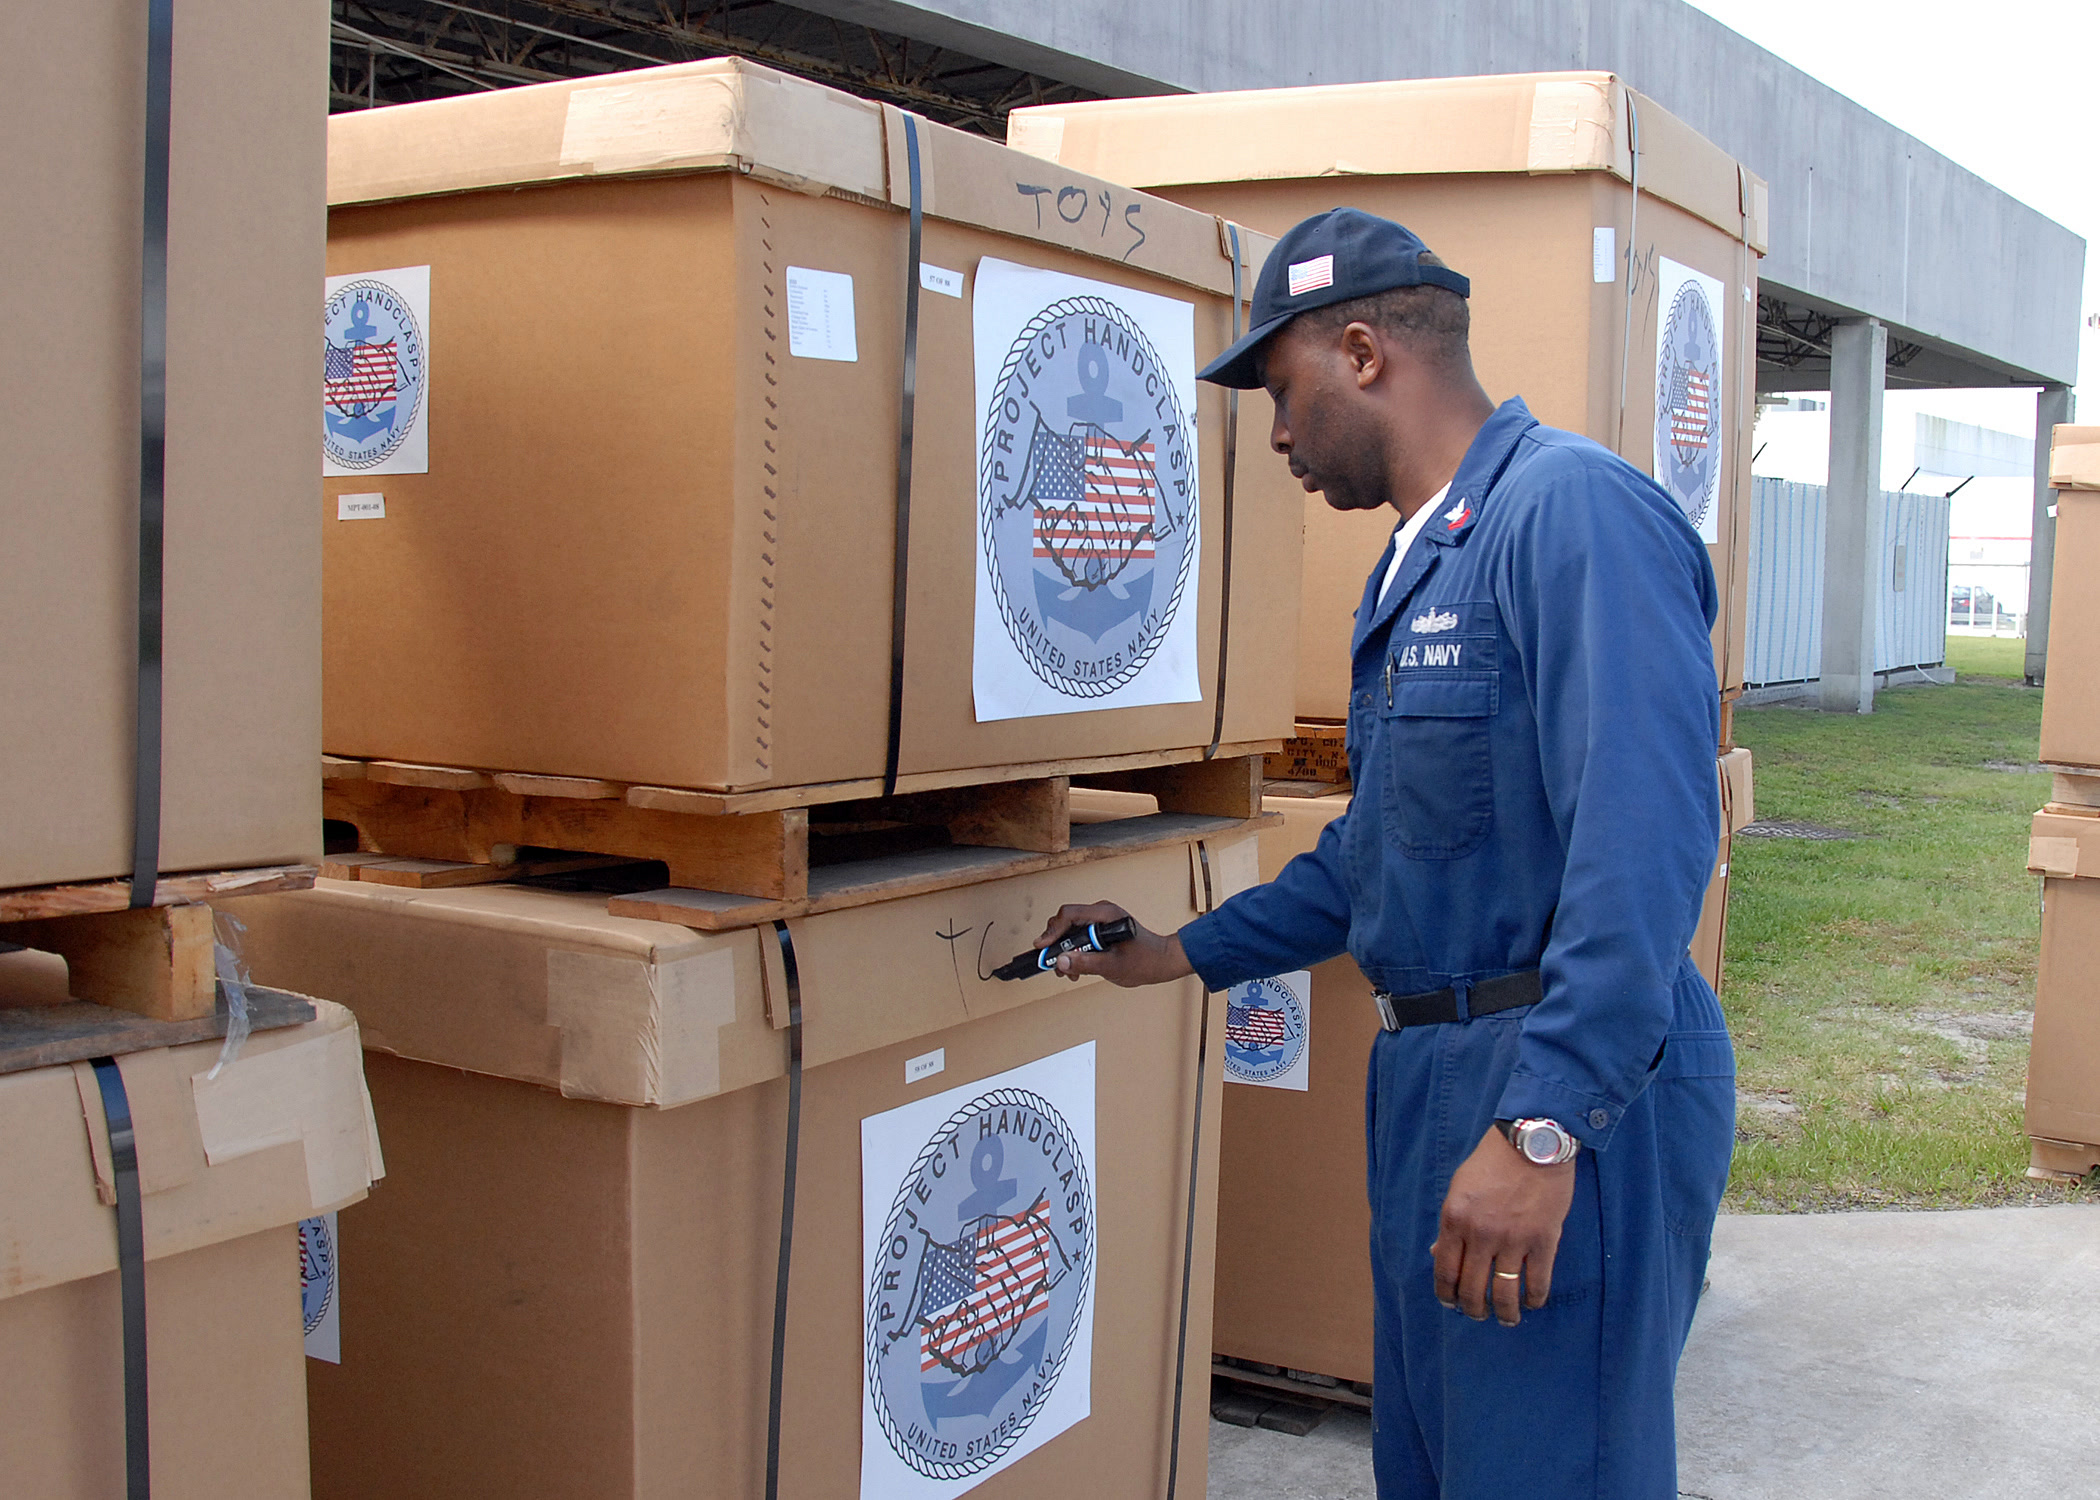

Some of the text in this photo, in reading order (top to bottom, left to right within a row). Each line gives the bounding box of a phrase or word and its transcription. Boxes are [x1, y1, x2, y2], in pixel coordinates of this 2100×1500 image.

[1016, 182, 1145, 262] TOYS
[356, 290, 419, 368] HANDCLASP
[348, 447, 378, 460] STATES
[380, 425, 400, 450] NAVY
[994, 318, 1186, 497] PROJECT HANDCLASP
[1019, 607, 1159, 678] UNITED STATES NAVY
[1422, 645, 1462, 667] NAVY
[880, 1109, 1083, 1322] PROJECT HANDCLASP
[907, 1353, 1054, 1460] UNITED STATES NAVY
